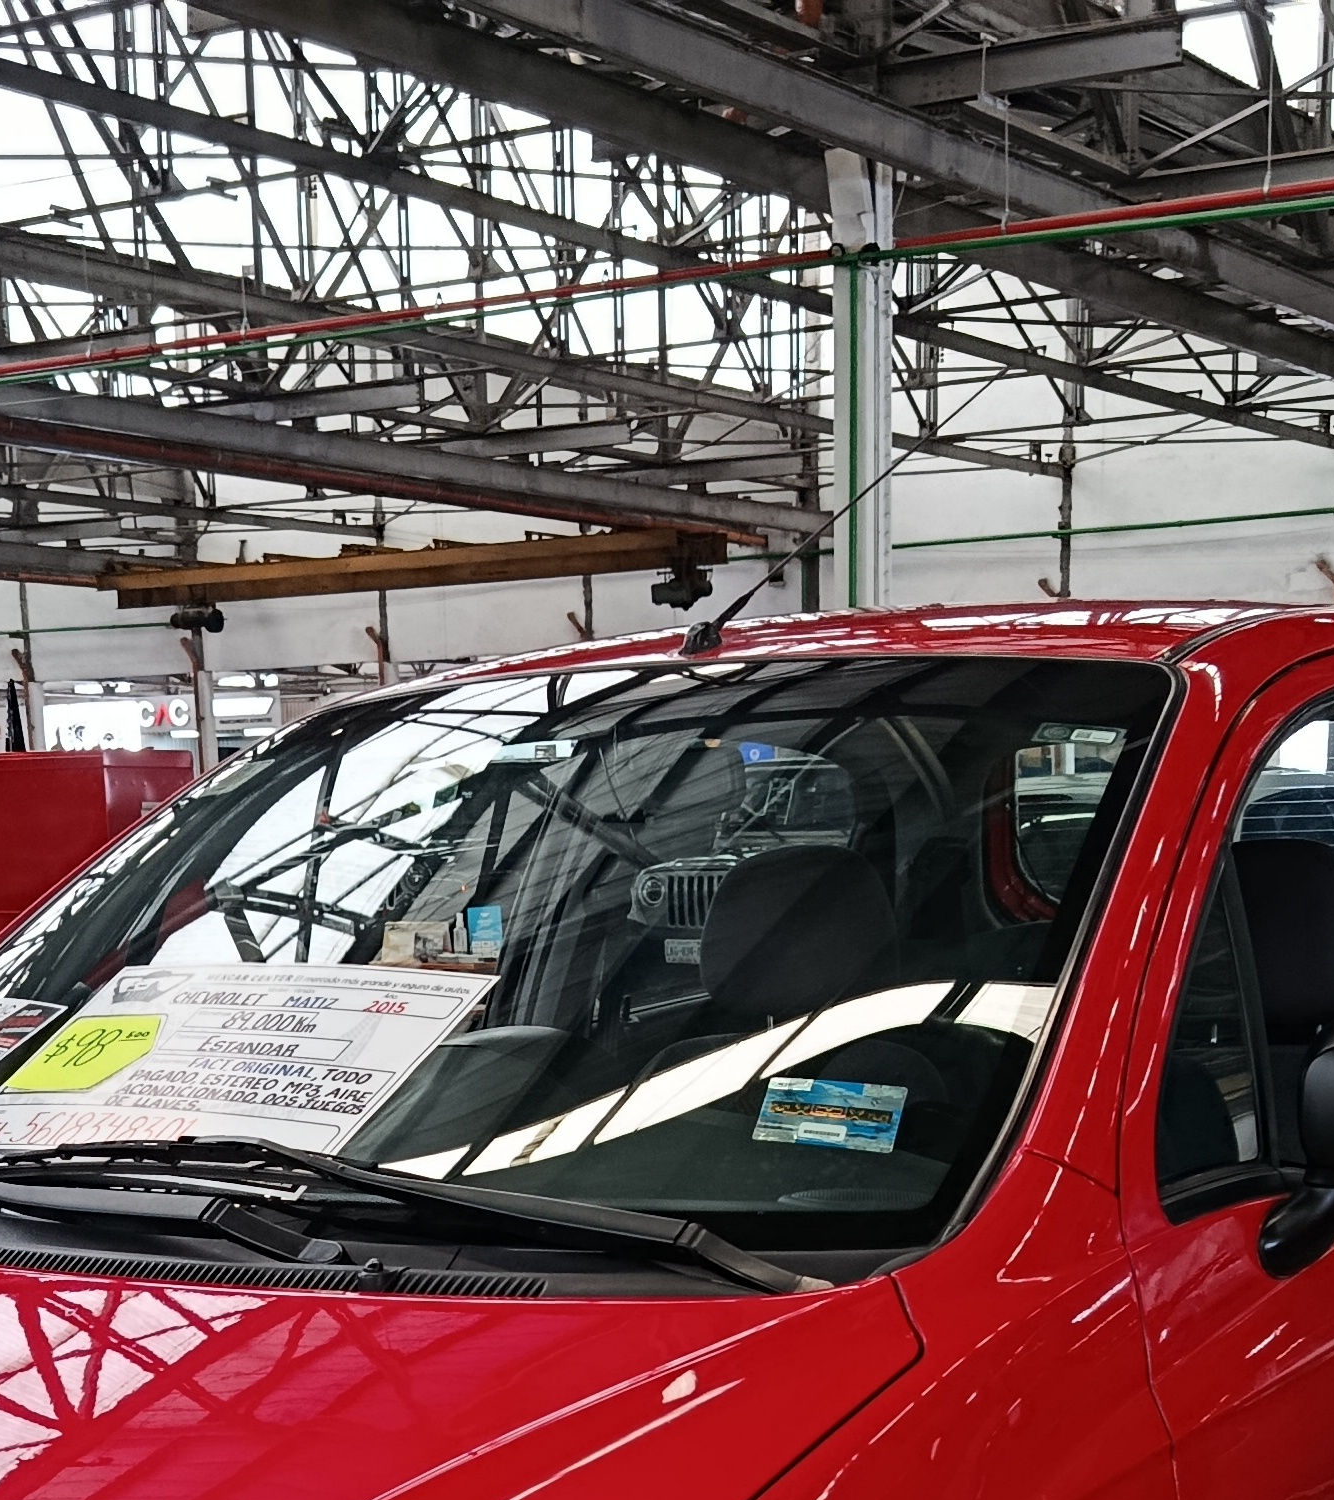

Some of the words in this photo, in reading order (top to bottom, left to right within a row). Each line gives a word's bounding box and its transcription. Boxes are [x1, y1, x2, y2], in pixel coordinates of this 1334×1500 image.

[172, 991, 269, 1006] CHEVROLET
[281, 996, 340, 1009] MATIZ
[363, 1000, 409, 1014] 2015
[321, 1068, 373, 1085] TODO
[200, 1074, 279, 1091] ESTEREO
[324, 1087, 374, 1103] AIRE
[260, 1093, 299, 1107] DOS
